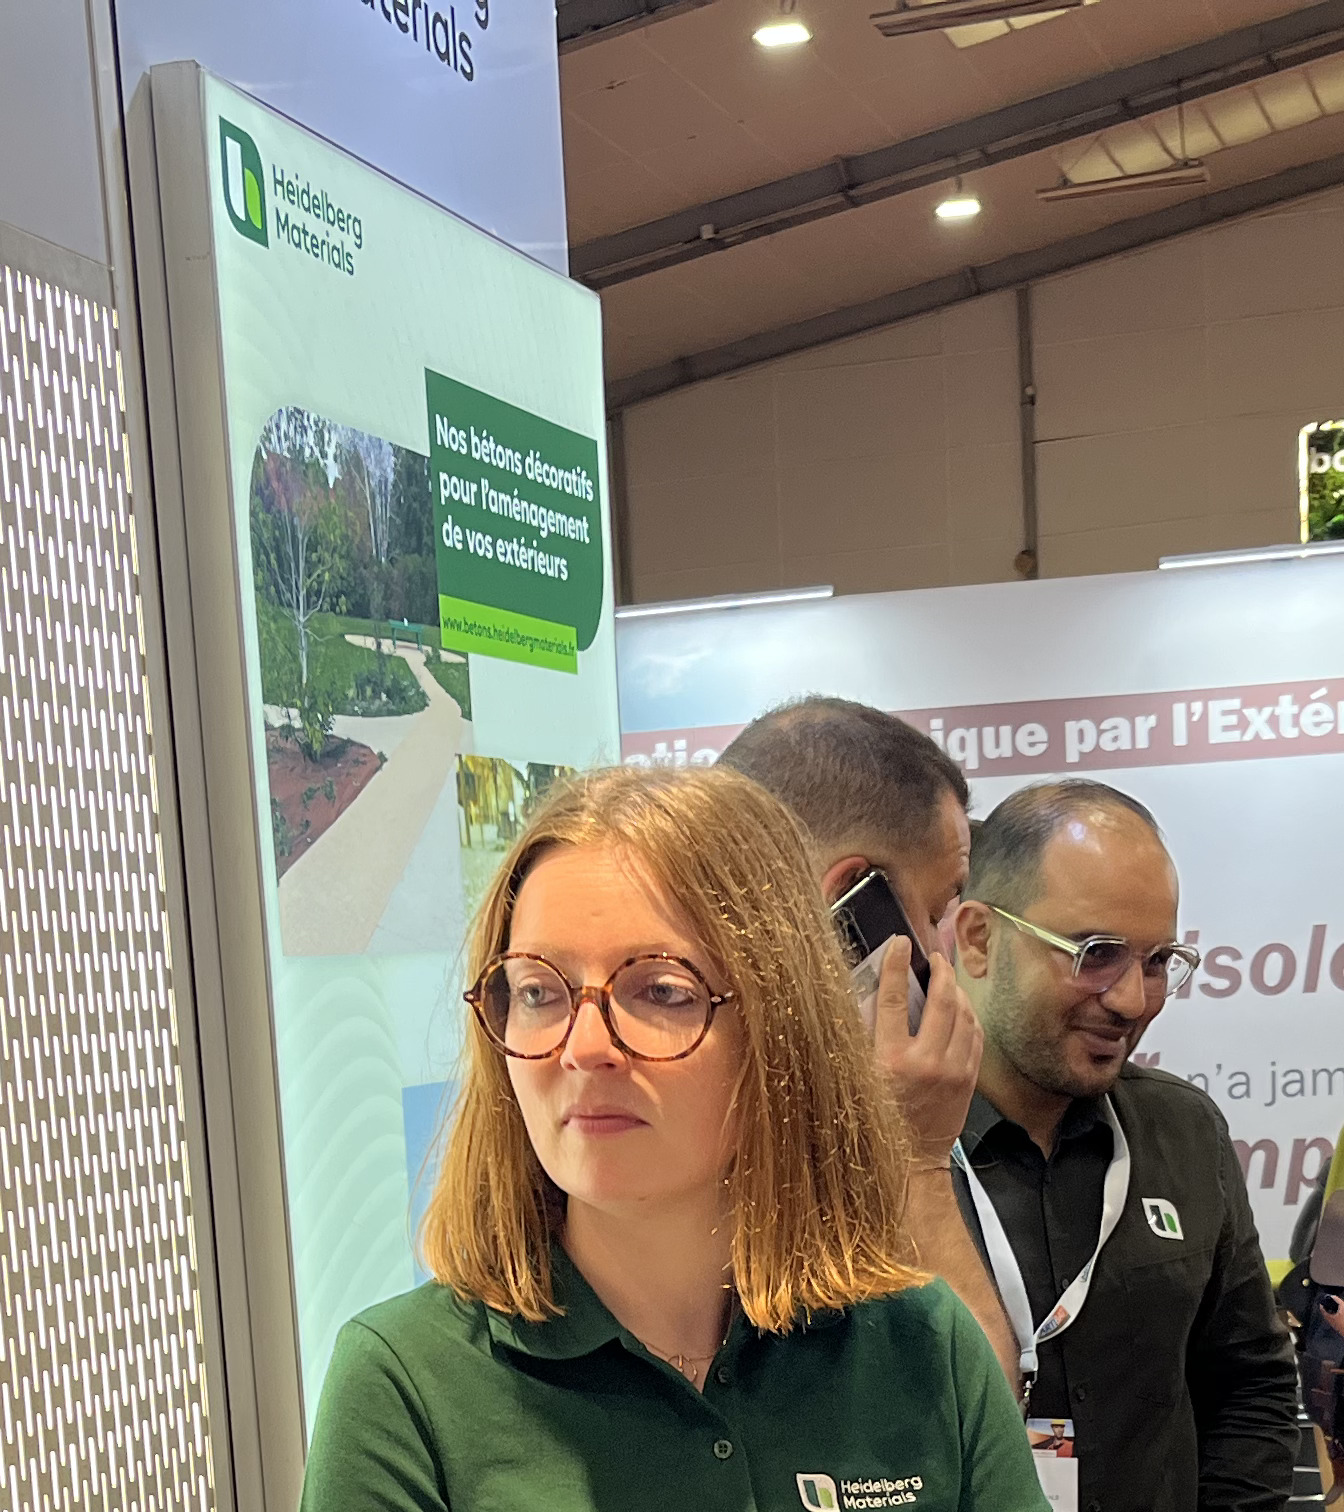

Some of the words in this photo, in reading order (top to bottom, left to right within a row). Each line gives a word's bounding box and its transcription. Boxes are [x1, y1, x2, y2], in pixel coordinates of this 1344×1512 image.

[360, 0, 474, 82] erials
[271, 163, 363, 250] Heidelberg
[275, 212, 355, 276] Materials
[434, 413, 468, 456] Nos
[471, 427, 522, 476] bétons
[525, 443, 594, 502] décoratifs
[439, 474, 480, 509] pour
[441, 519, 464, 550] de
[466, 531, 494, 559] vos
[496, 530, 569, 581] extérieurs
[1064, 713, 1158, 763] par
[841, 1475, 924, 1494] Heidelberg
[844, 1490, 917, 1510] Materials
